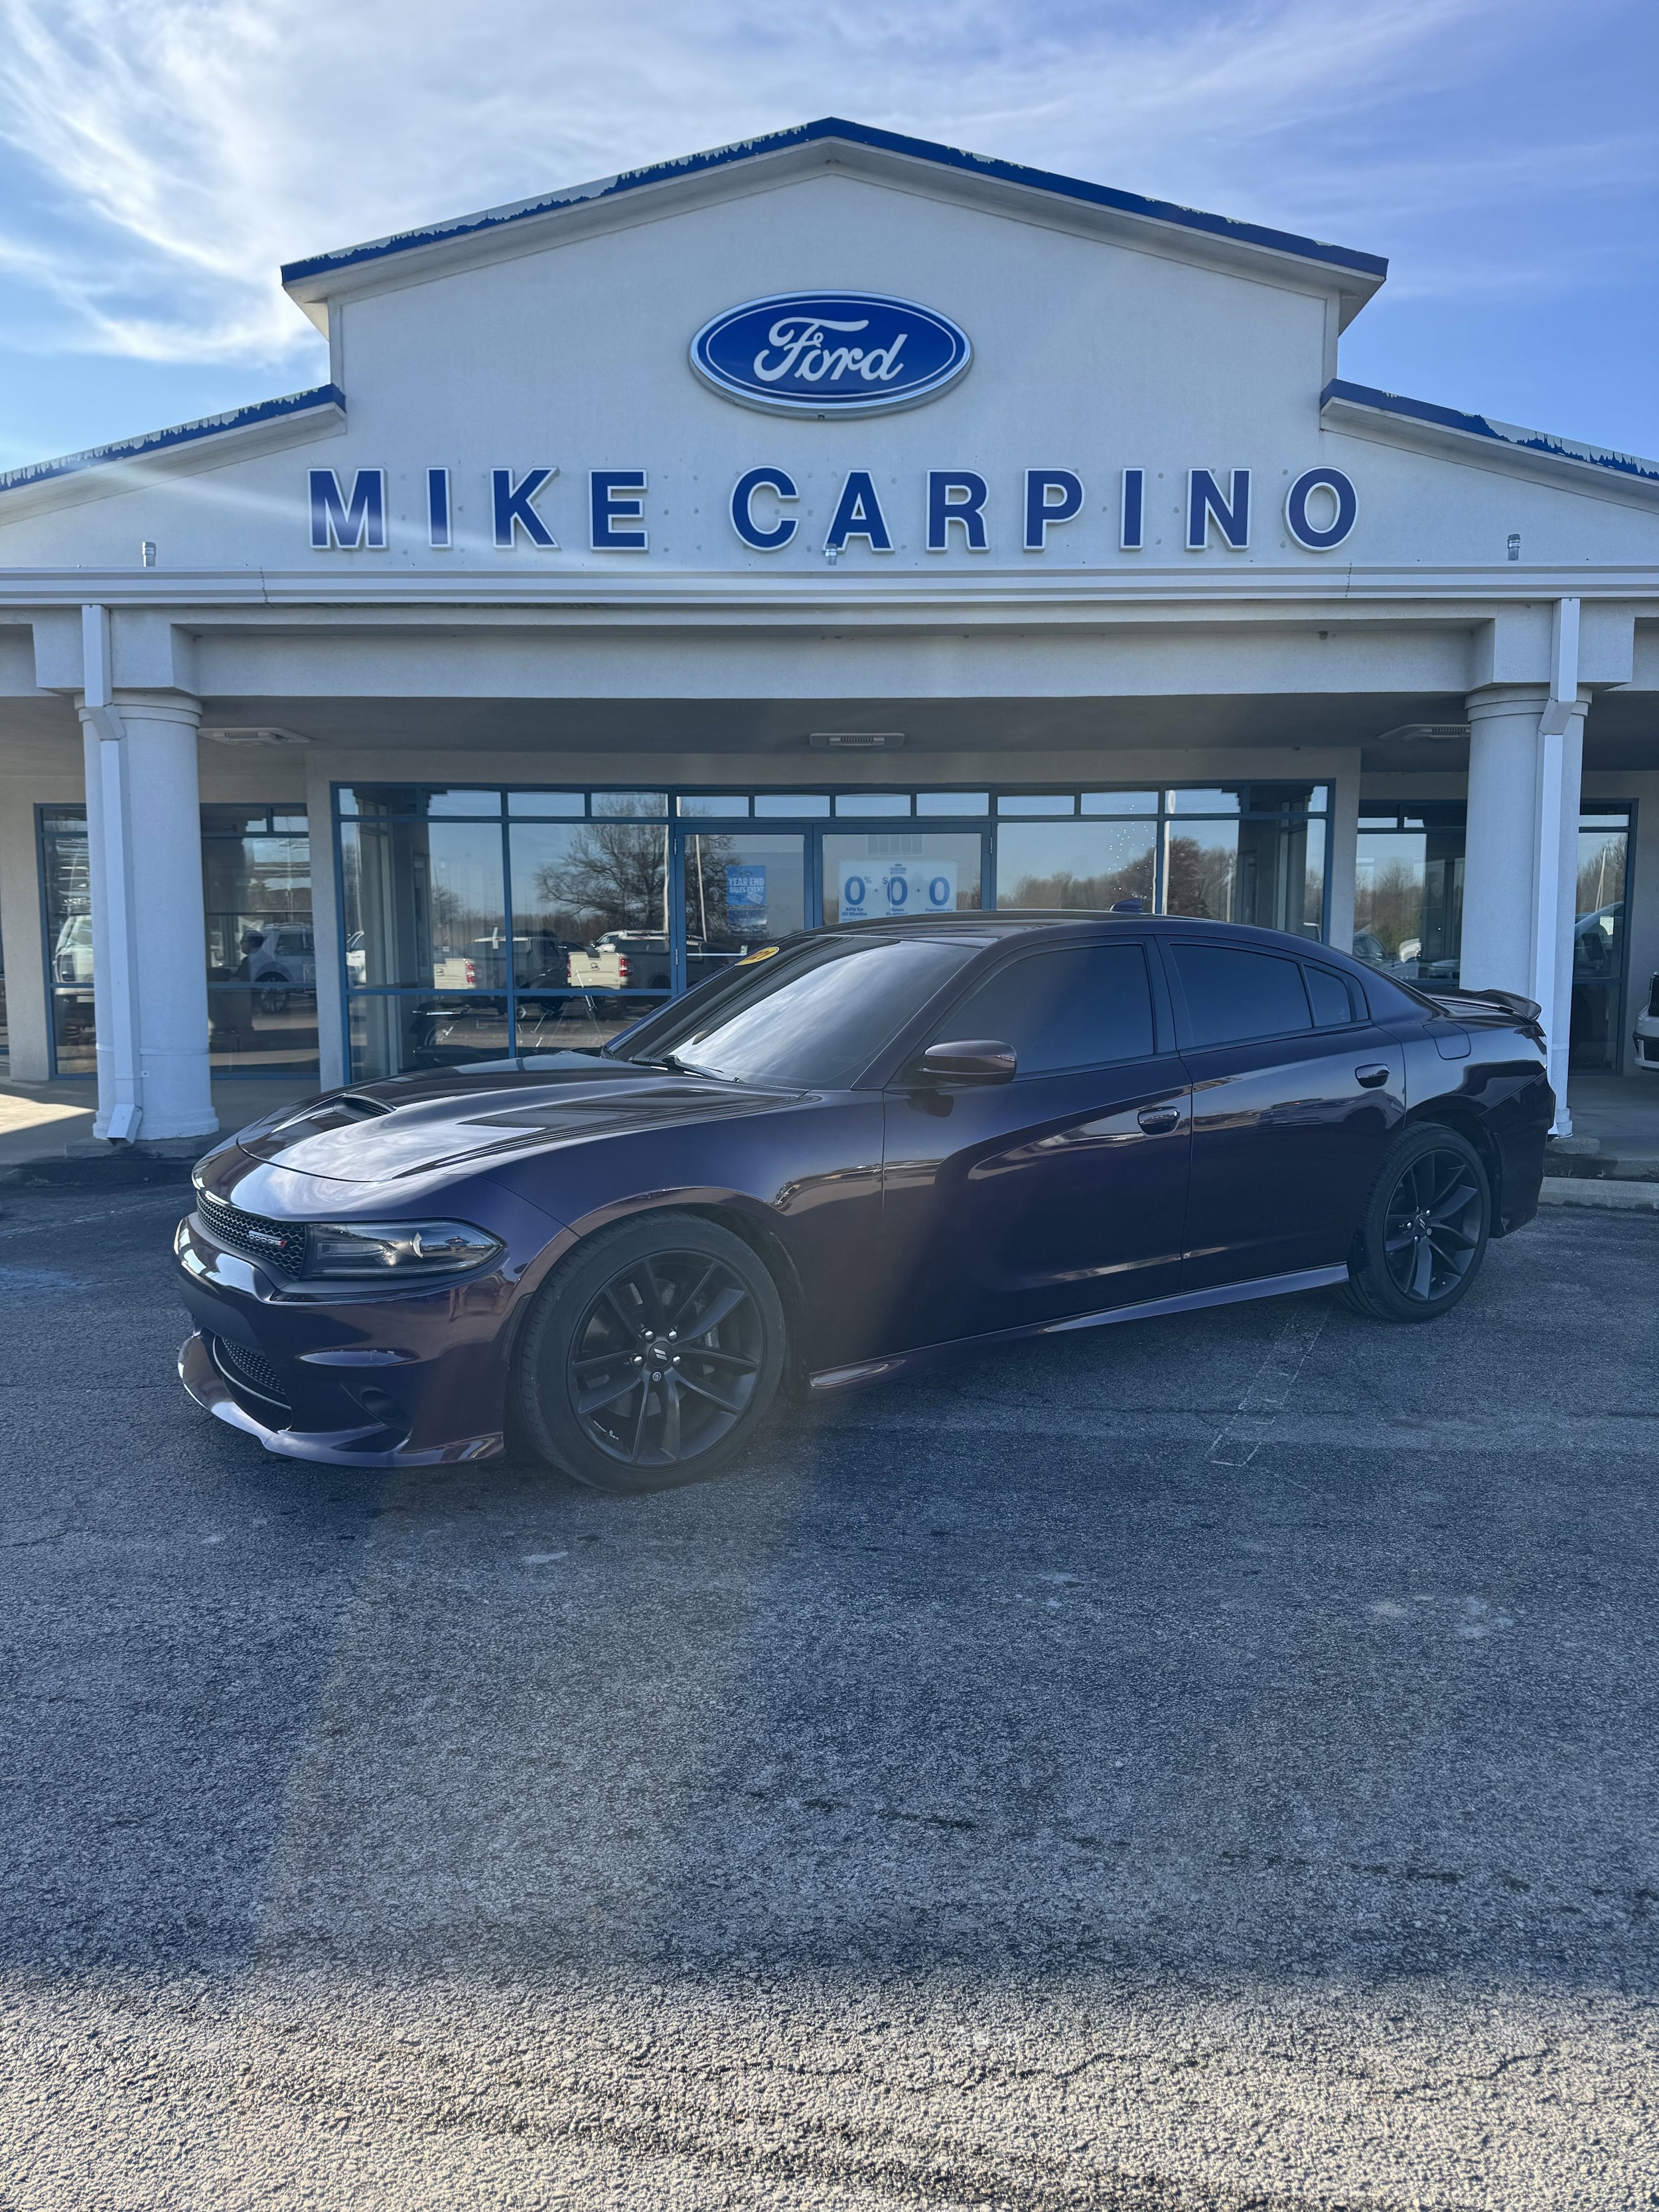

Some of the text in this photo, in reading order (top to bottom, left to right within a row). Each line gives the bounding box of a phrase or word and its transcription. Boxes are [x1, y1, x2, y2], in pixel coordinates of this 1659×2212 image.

[754, 317, 908, 382] Ford
[308, 466, 1359, 552] MIKE CARPINO
[728, 877, 764, 887] YEAR END
[930, 877, 950, 906] 0
[249, 1234, 282, 1246] DODGE
